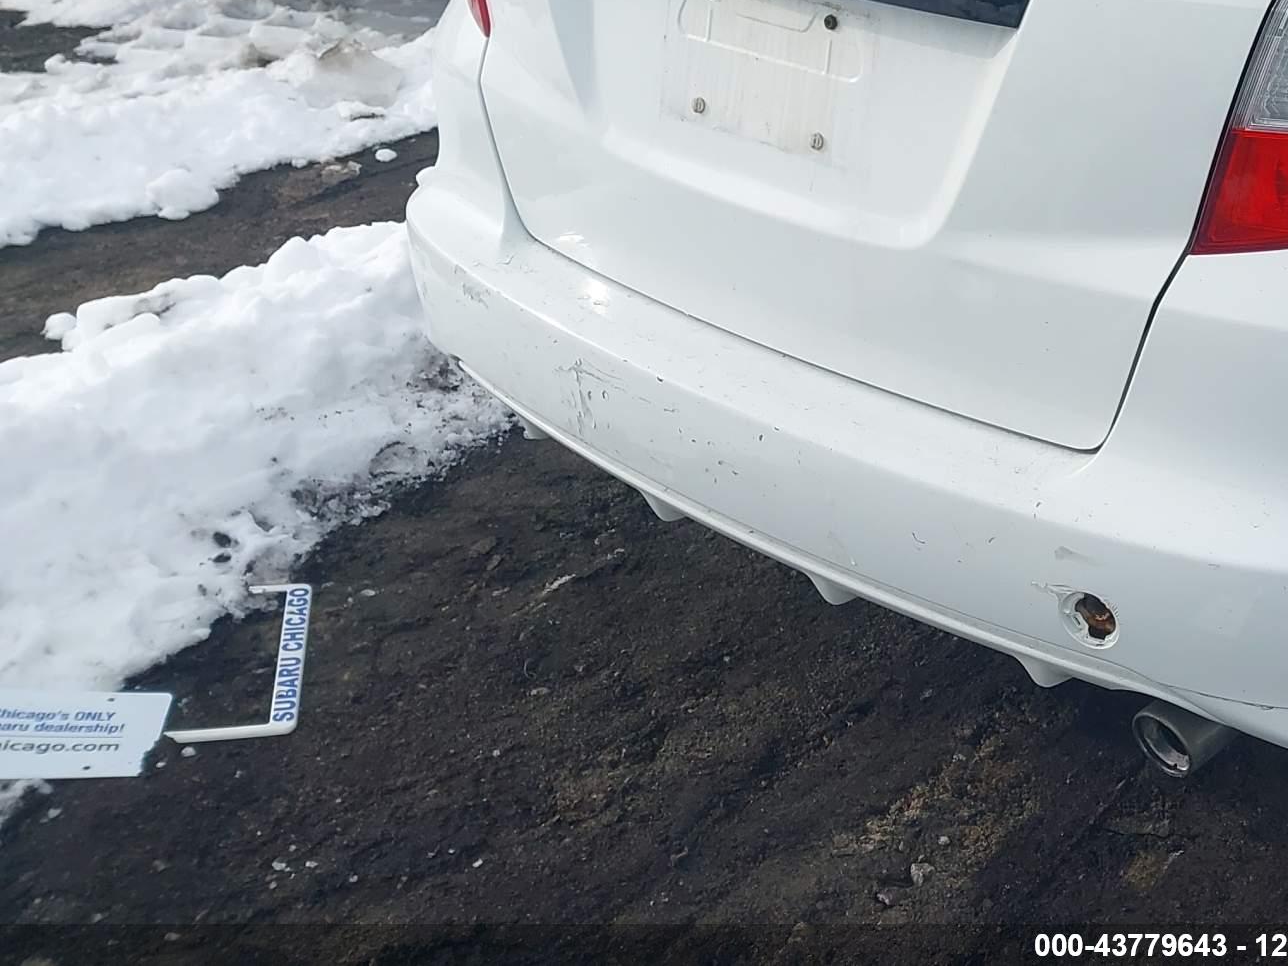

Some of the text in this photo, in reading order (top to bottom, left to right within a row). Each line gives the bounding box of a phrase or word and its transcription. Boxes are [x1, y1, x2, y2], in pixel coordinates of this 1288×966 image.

[272, 588, 310, 722] SUBARU CHICAGO
[74, 711, 116, 722] ONLY
[0, 722, 125, 735] aru dealership!
[0, 740, 120, 755] icago.com
